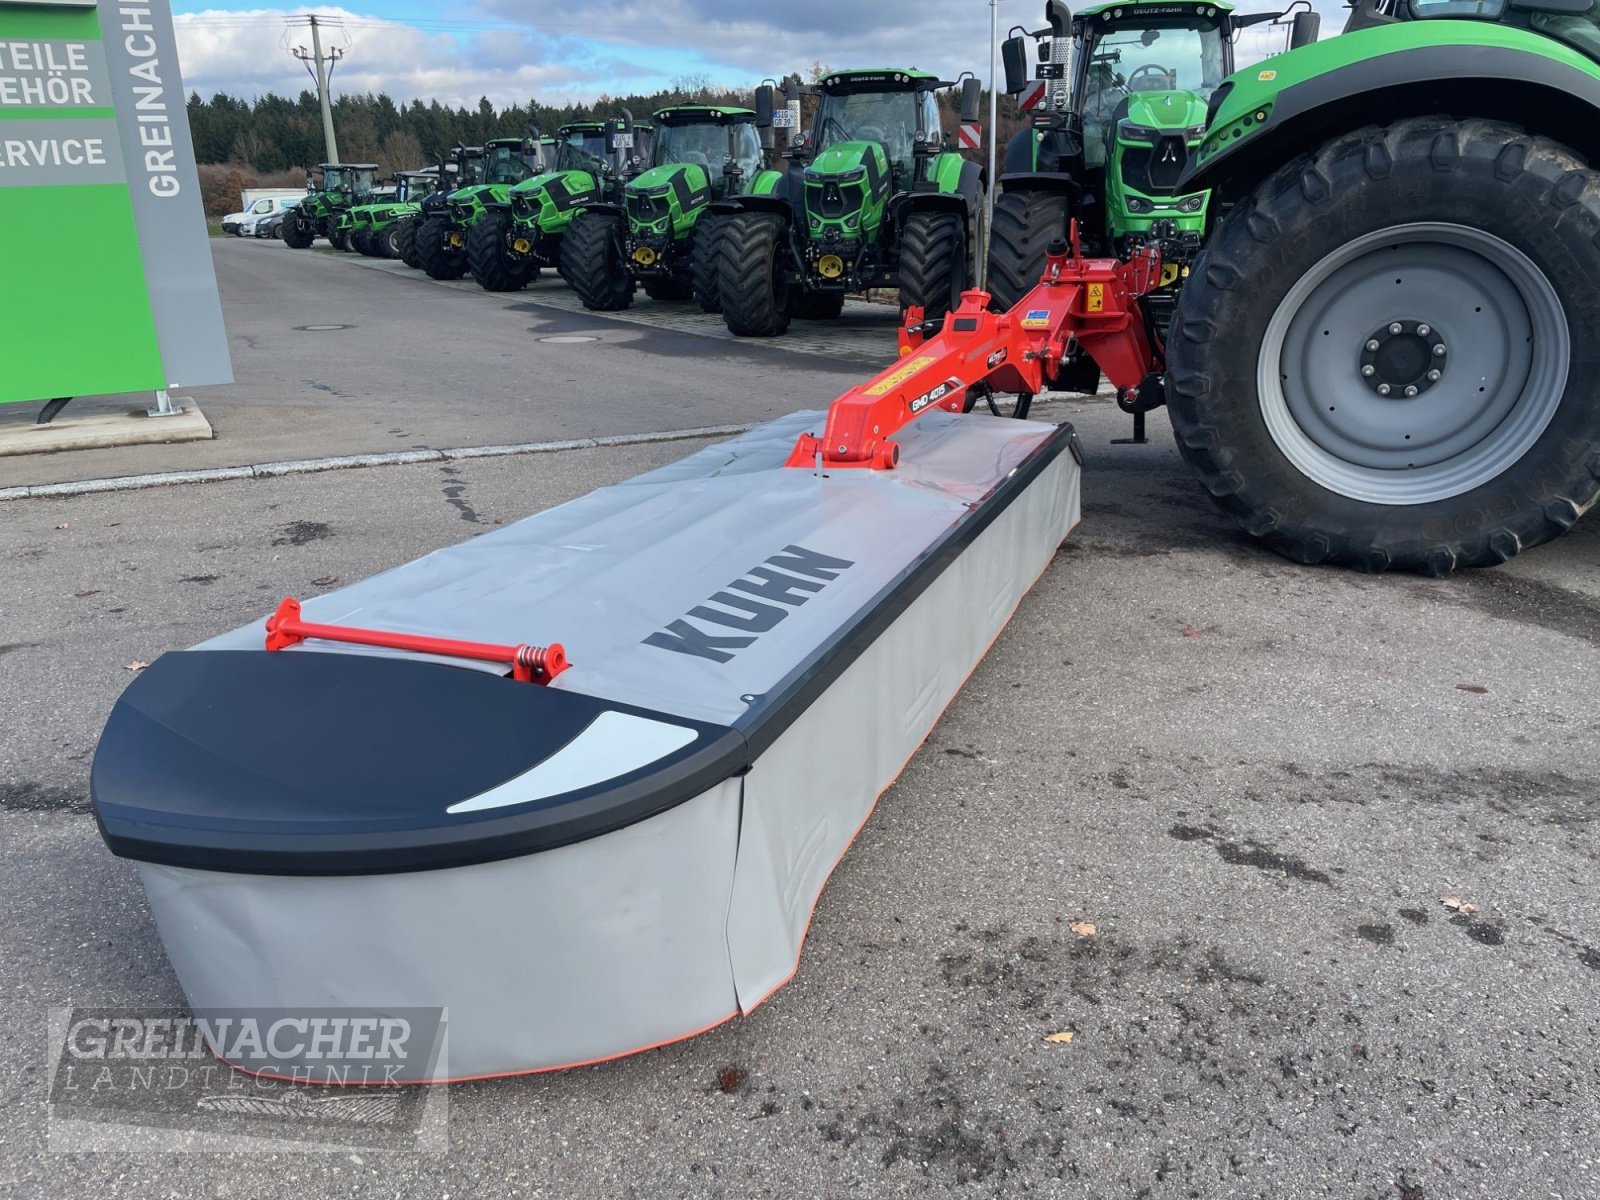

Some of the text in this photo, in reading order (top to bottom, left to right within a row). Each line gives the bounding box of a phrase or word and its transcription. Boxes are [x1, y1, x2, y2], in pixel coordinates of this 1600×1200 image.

[1133, 7, 1183, 15] DEUTZ-FAHR
[118, 0, 180, 197] GREINACH
[0, 139, 106, 167] RVICE
[912, 384, 946, 411] GMD 4015
[640, 544, 855, 664] KUHN
